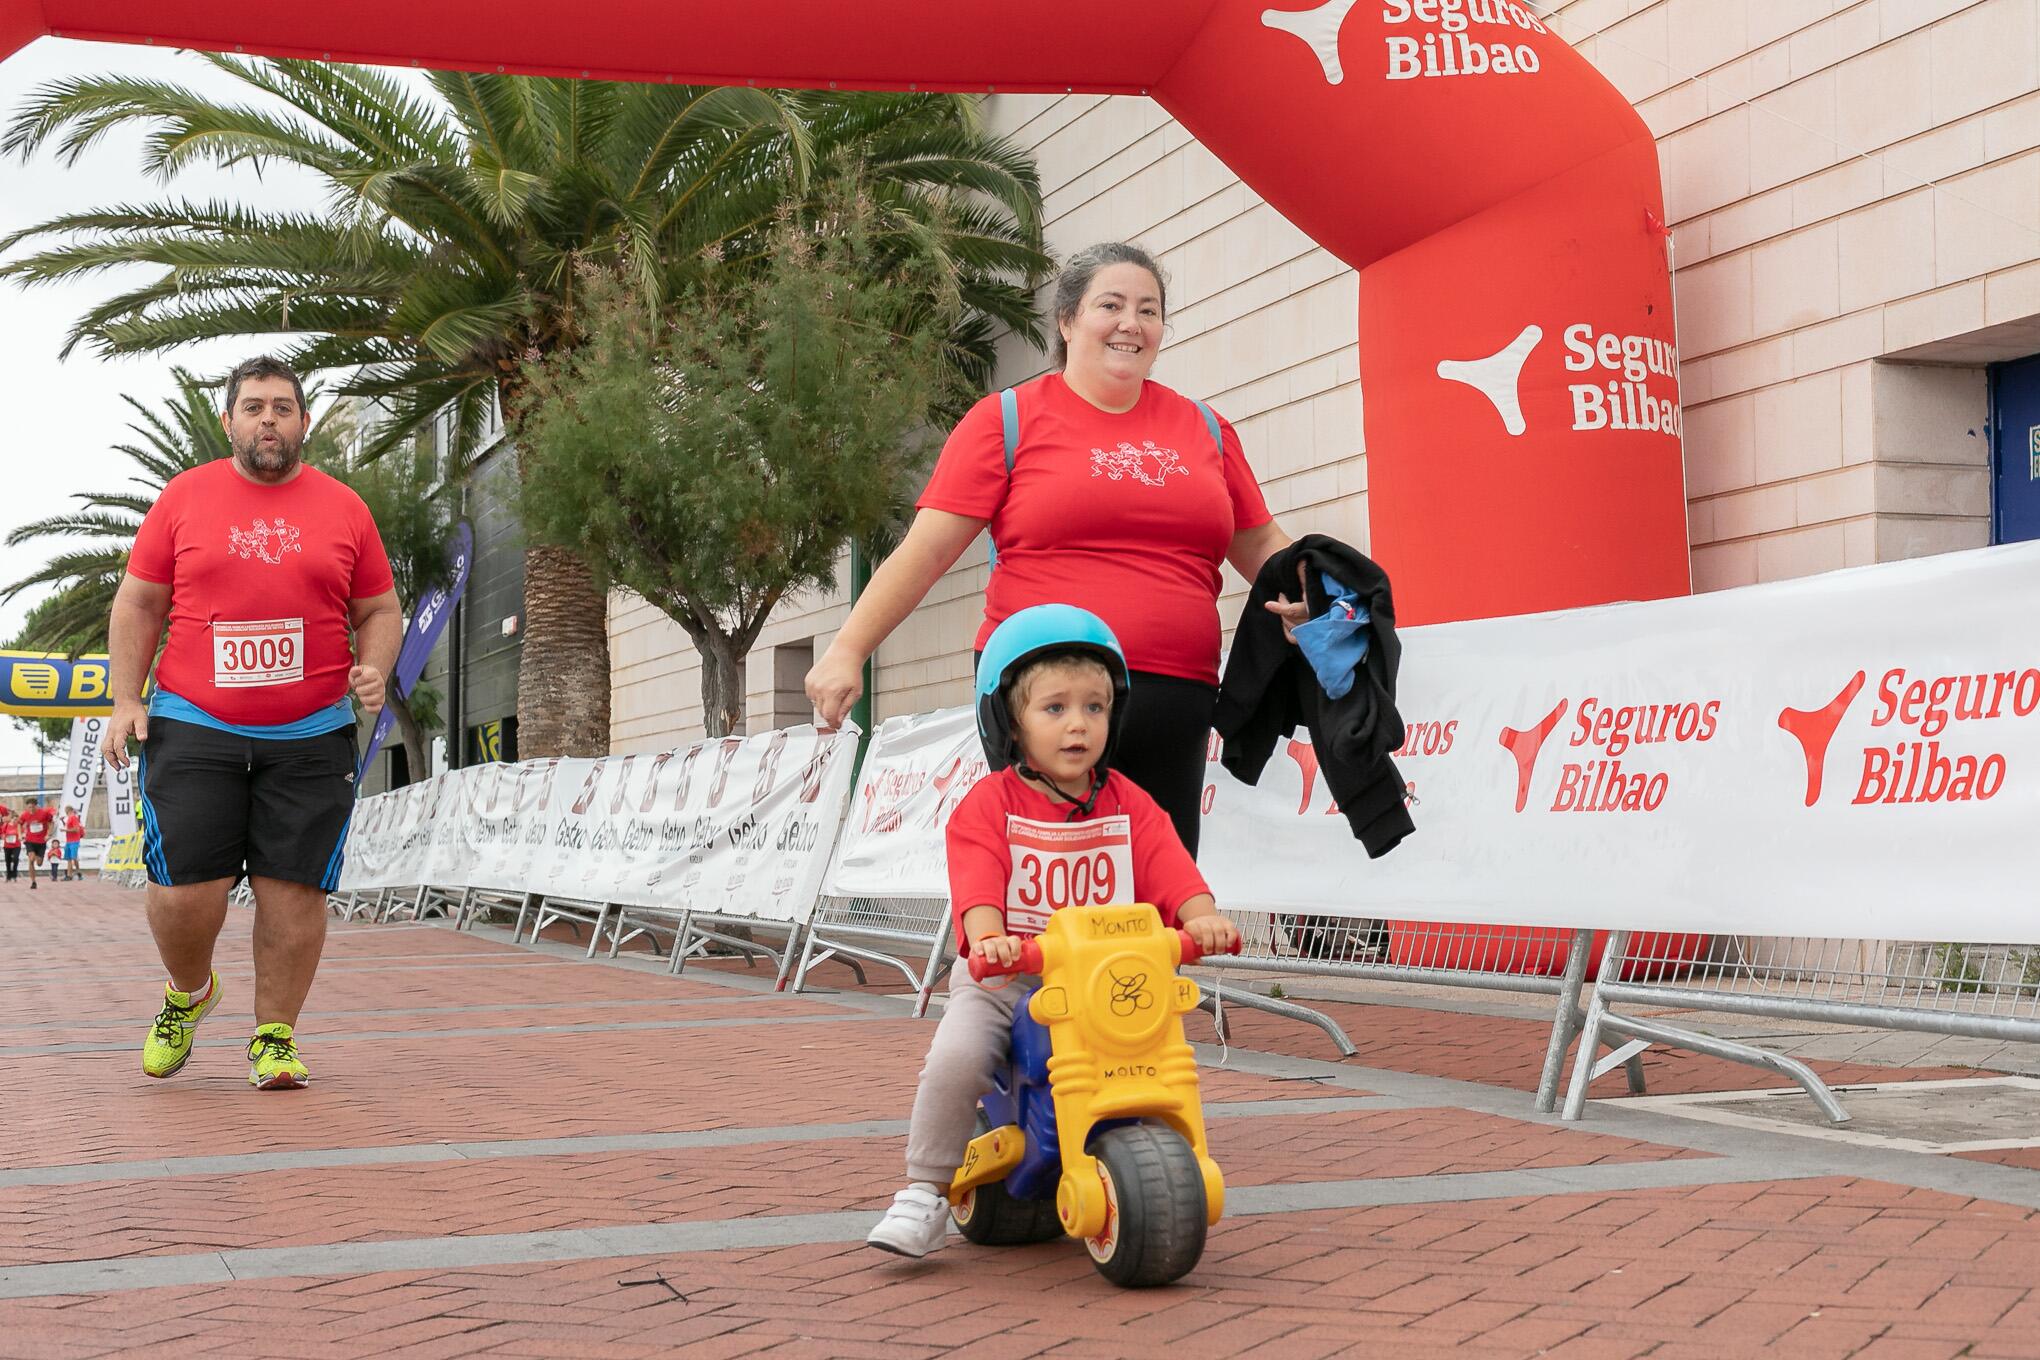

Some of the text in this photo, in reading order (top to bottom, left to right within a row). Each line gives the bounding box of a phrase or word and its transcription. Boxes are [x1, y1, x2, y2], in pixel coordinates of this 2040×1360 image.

[1385, 32, 1540, 80] Bilbao
[223, 636, 295, 671] 3009
[1393, 720, 1459, 757] uros
[1569, 697, 1721, 757] Seguros
[73, 718, 101, 798] CORREO
[1851, 740, 2006, 805] Bilbao
[116, 789, 130, 815] EL
[1550, 760, 1669, 812] Bilbao
[1017, 851, 1116, 911] 3009
[1104, 1065, 1156, 1078] MOLTO
